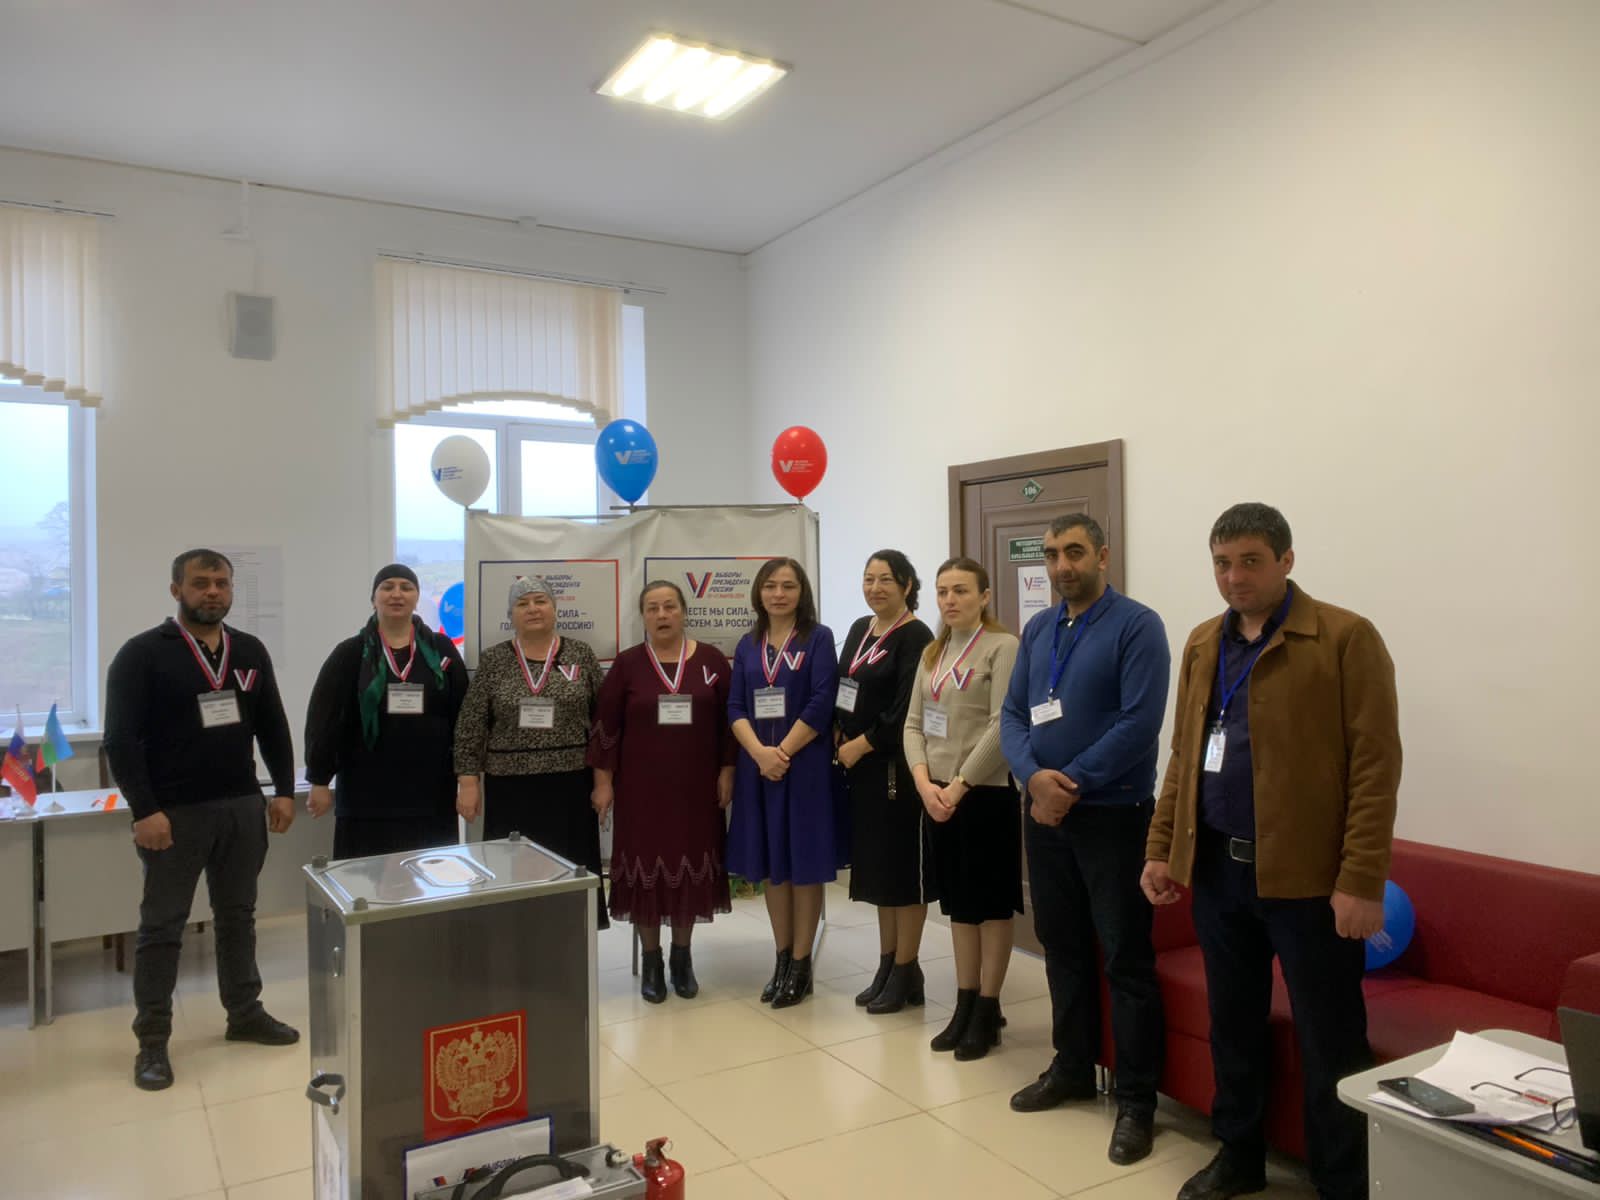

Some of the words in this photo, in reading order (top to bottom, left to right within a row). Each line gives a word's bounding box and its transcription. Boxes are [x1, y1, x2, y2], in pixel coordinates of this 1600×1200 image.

[711, 578, 751, 586] ПРЕЗИДЕНТА
[557, 609, 580, 618] СИЛА
[709, 607, 724, 616] МЫ
[726, 607, 749, 616] СИЛА
[713, 618, 723, 627] ЗА
